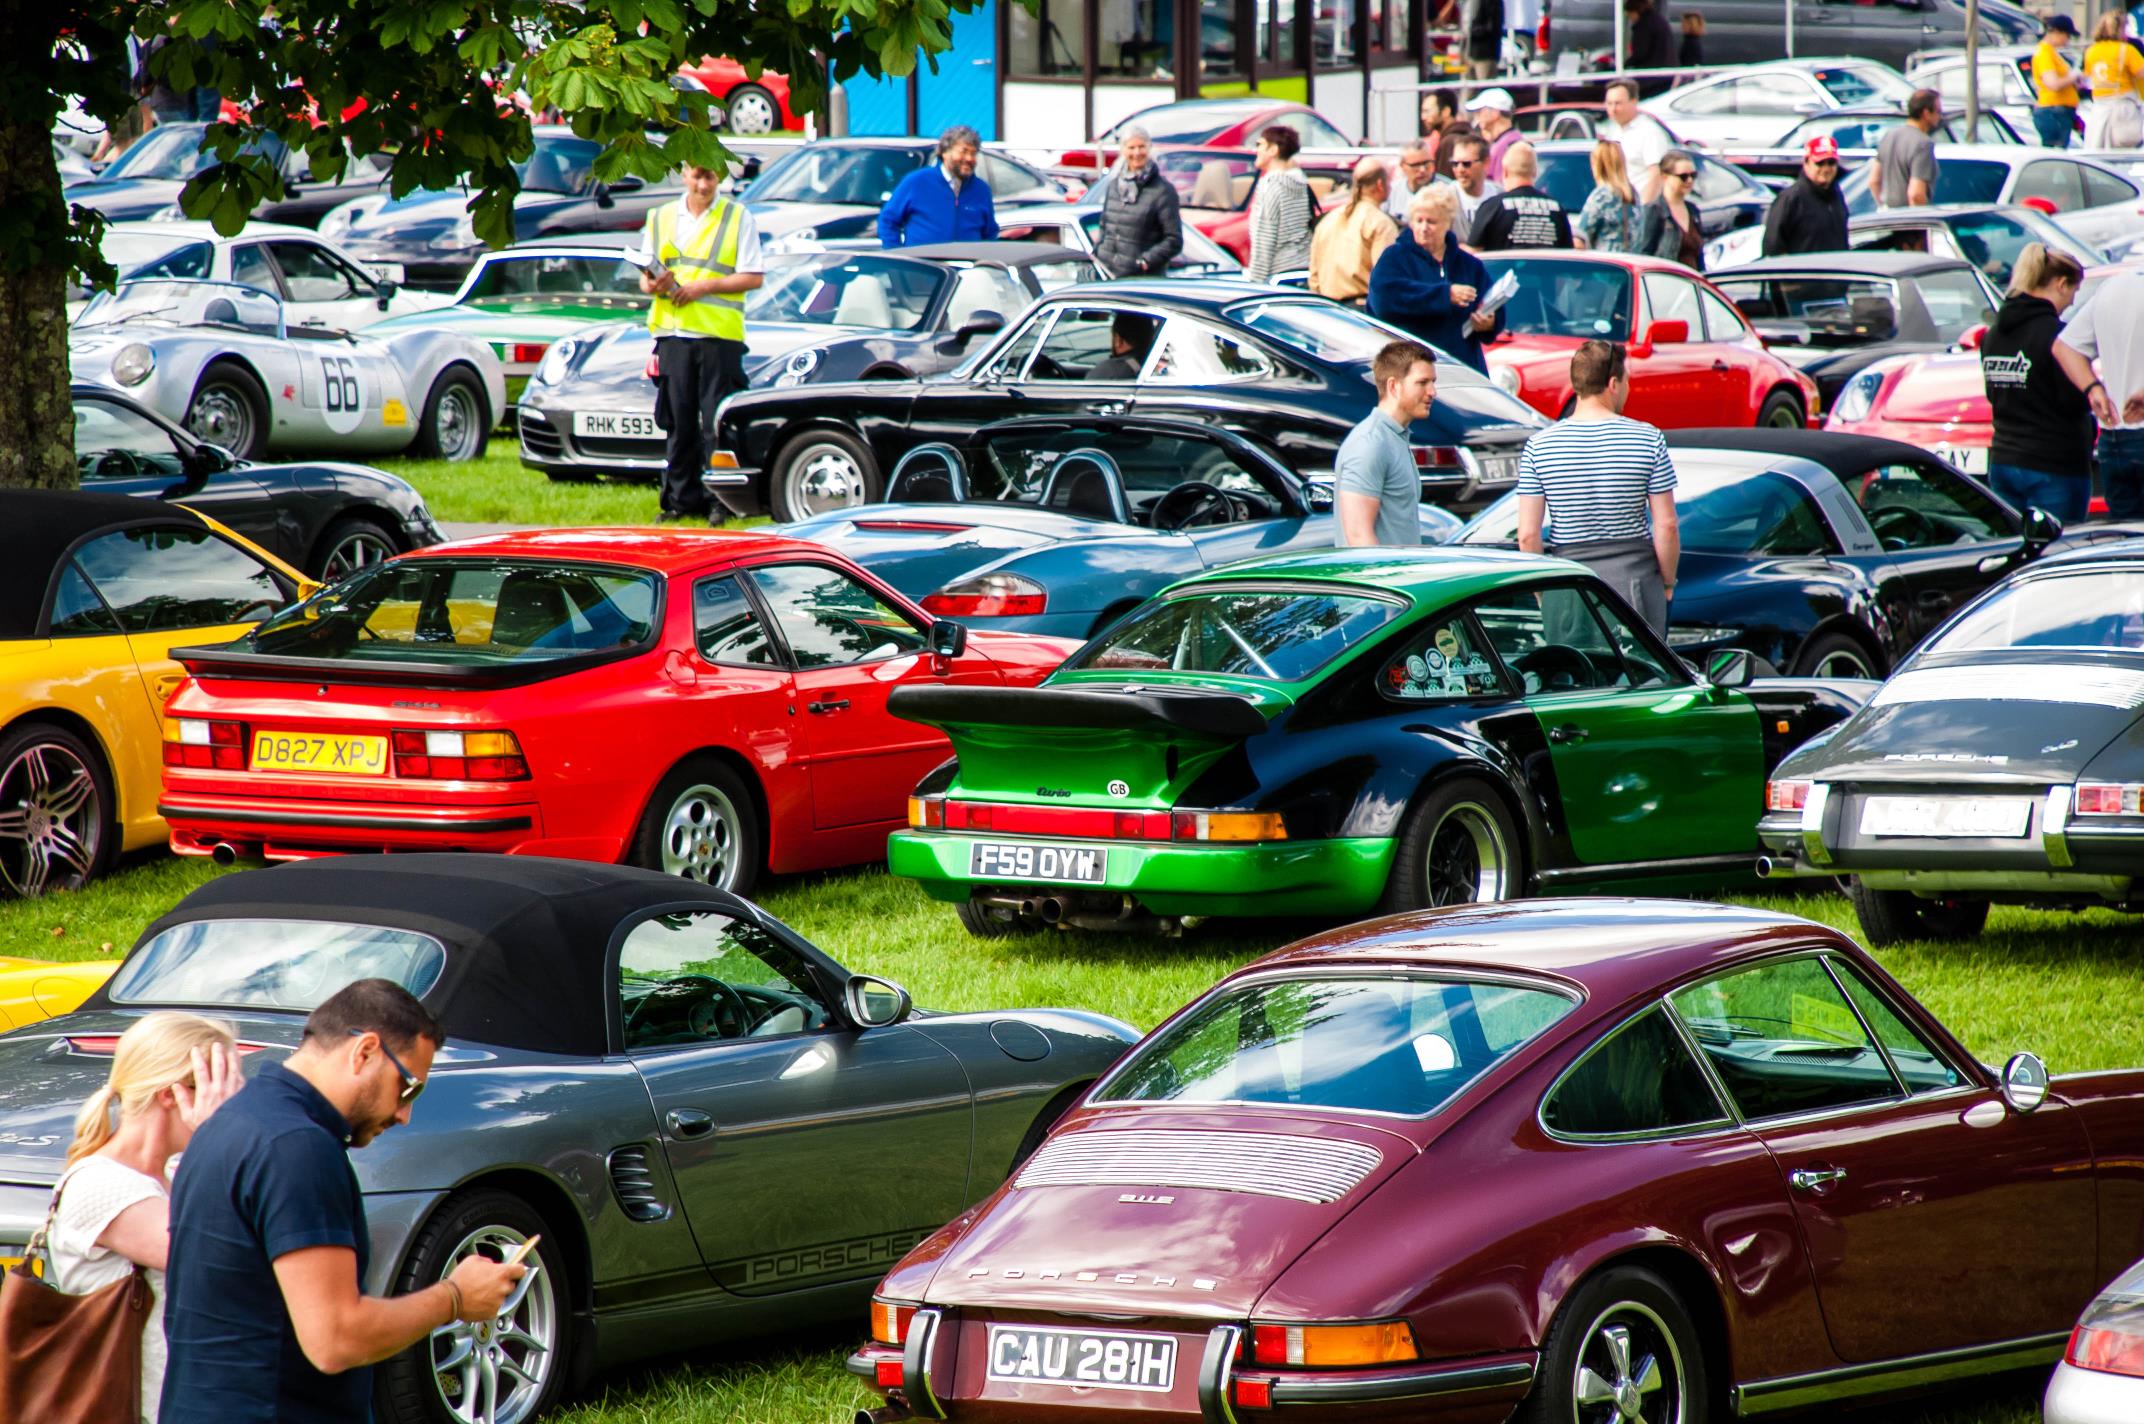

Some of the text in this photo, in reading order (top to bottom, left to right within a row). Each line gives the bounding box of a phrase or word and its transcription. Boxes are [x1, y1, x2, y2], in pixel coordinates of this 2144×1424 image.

[320, 357, 359, 412] 66
[586, 416, 653, 435] RHK 593
[257, 737, 382, 767] D827 XPJ
[1110, 783, 1126, 795] GB
[979, 844, 1096, 880] F59 OYW
[752, 1235, 914, 1280] PORSCHE
[968, 1267, 1217, 1291] PORSCHE
[993, 1333, 1171, 1386] CAU 281H
